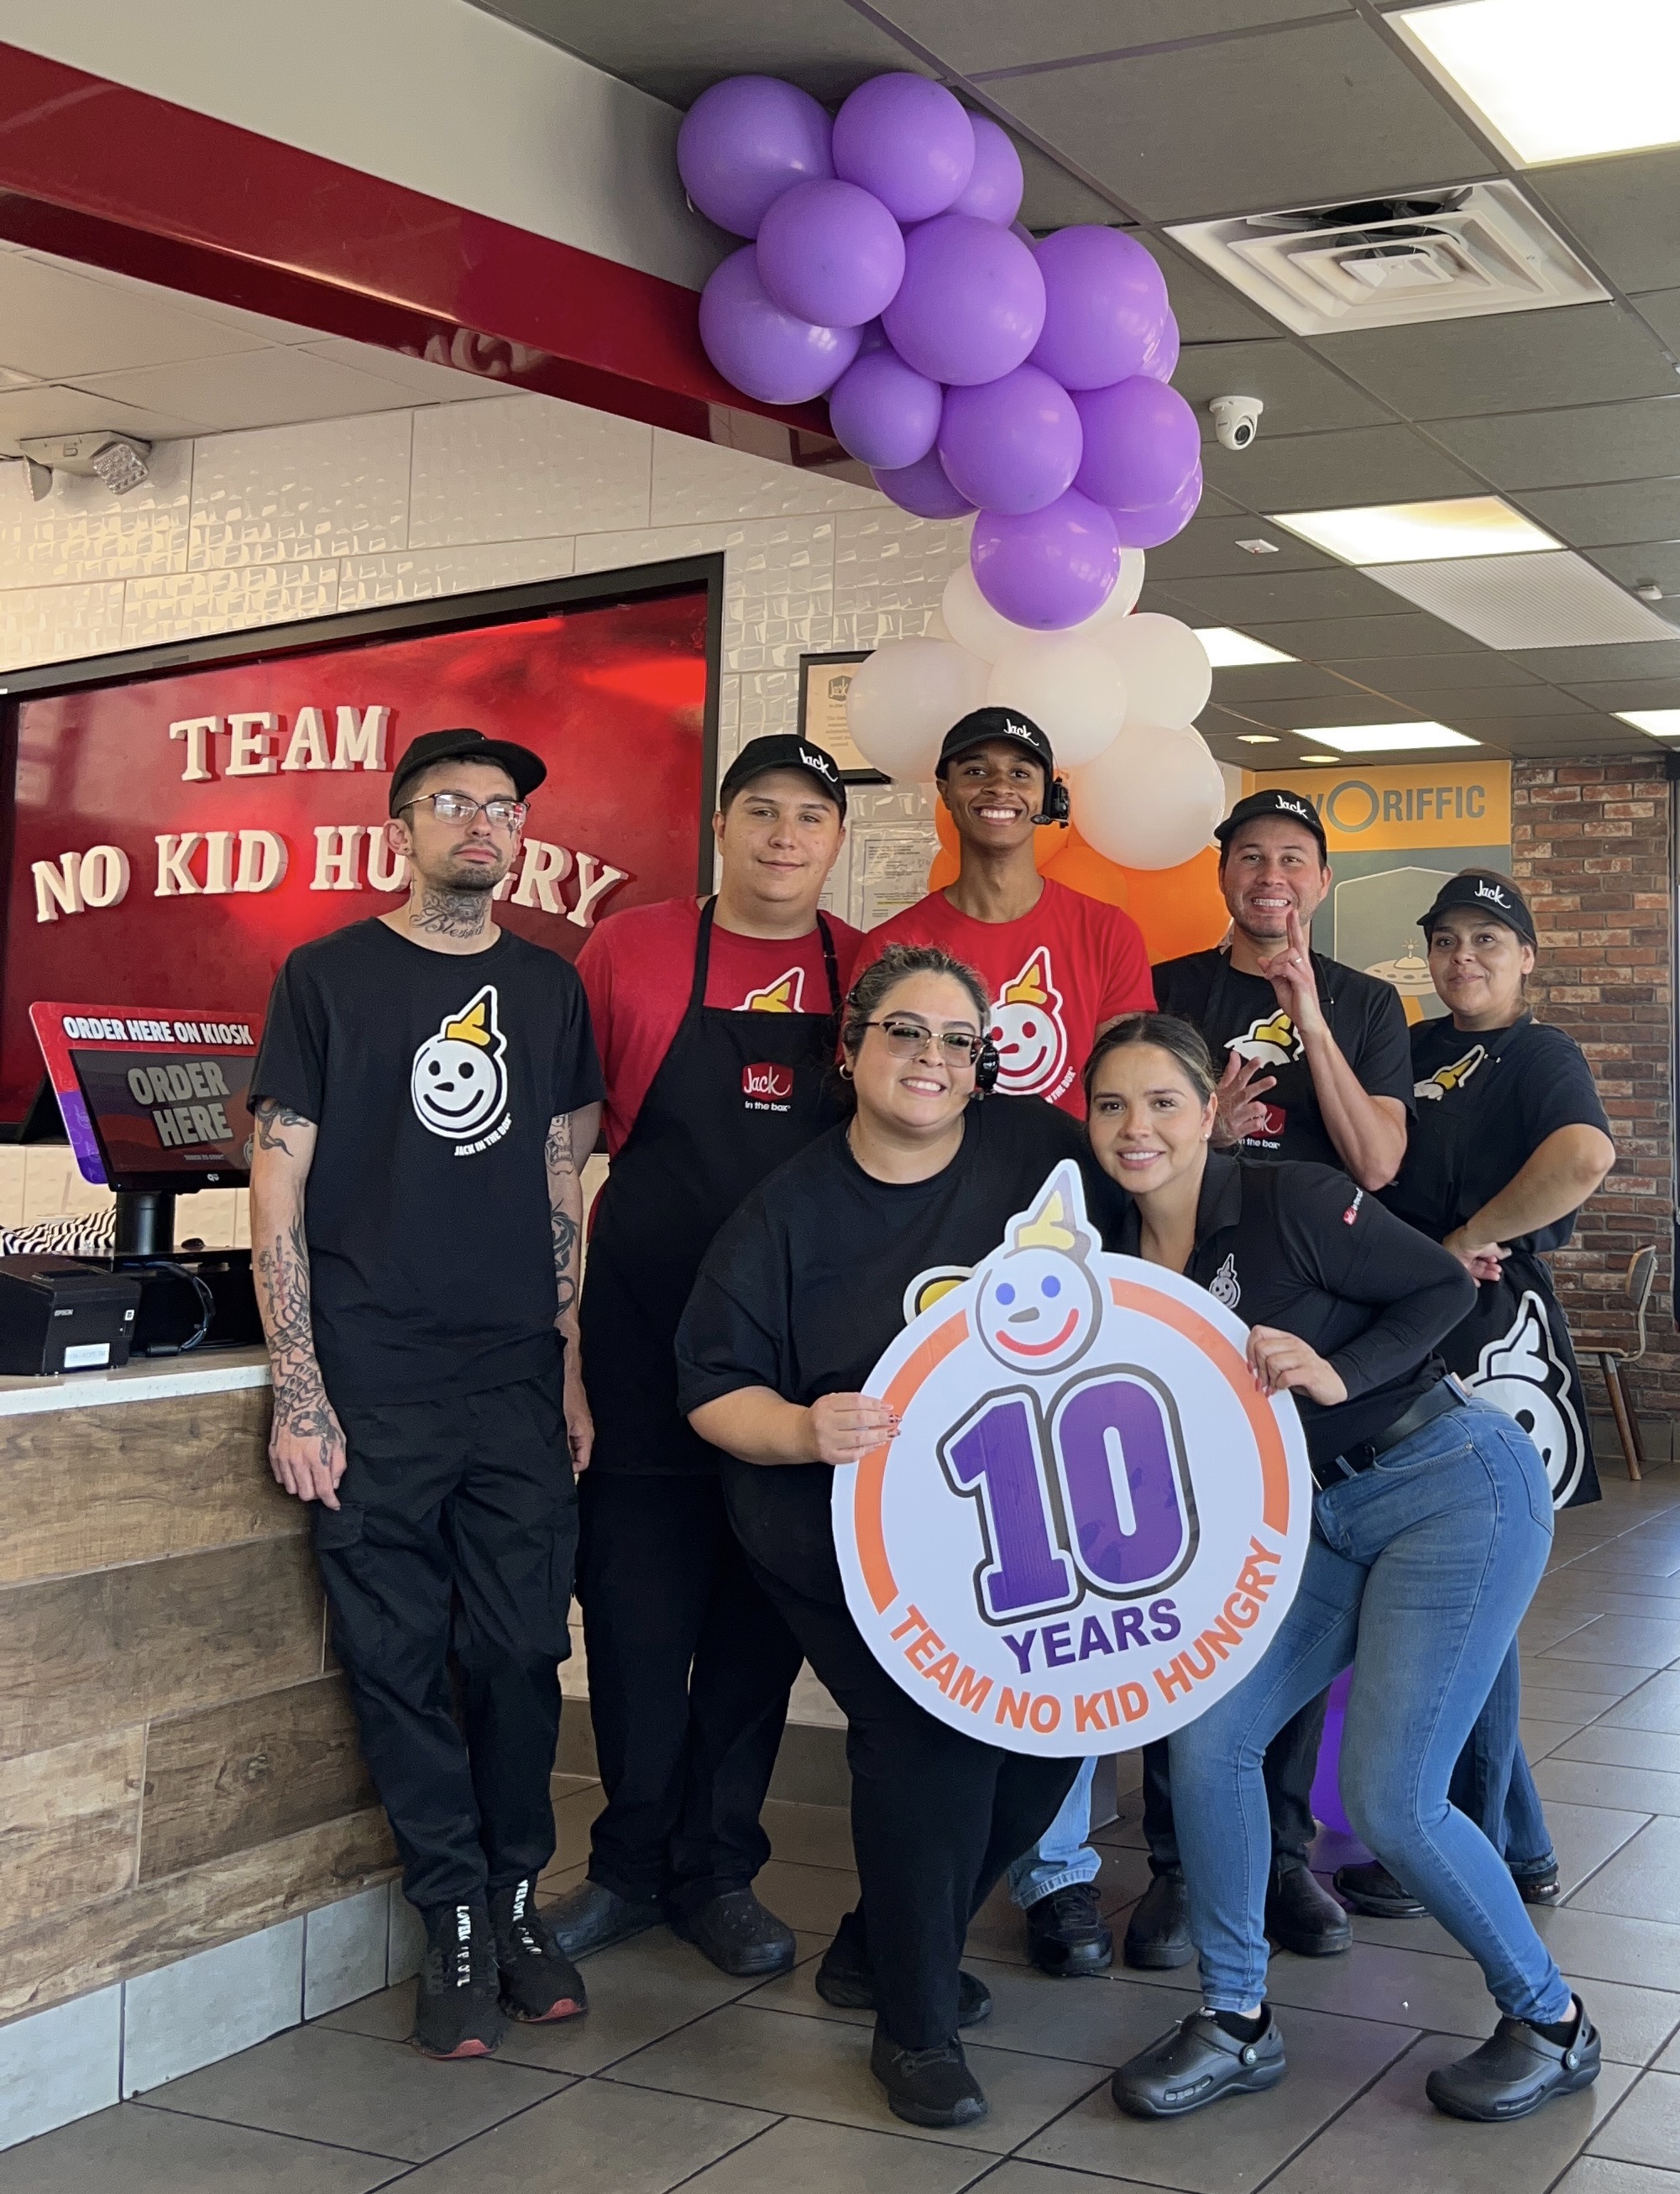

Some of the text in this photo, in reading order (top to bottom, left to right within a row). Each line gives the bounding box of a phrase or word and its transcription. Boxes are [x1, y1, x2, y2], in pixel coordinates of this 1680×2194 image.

[169, 704, 393, 782] TEAM
[1003, 718, 1039, 746] Jack
[798, 746, 839, 783] Jack
[1275, 794, 1309, 820] Jack
[31, 825, 630, 929] NO KID HURY
[1473, 879, 1511, 909] Jack
[63, 1016, 254, 1045] ORDER HERE ON KIOSK
[128, 1060, 230, 1106] ORDER
[743, 1066, 791, 1097] Jack
[152, 1102, 233, 1147] HERE
[745, 1101, 754, 1109] in
[754, 1102, 770, 1111] the
[453, 1143, 476, 1156] JACK
[474, 1139, 487, 1152] IN
[483, 1130, 502, 1146] THE
[944, 1369, 1196, 1622] 10
[888, 1534, 1282, 1735] TEAM NO KID HUNGRY
[1001, 1599, 1182, 1675] YEARS
